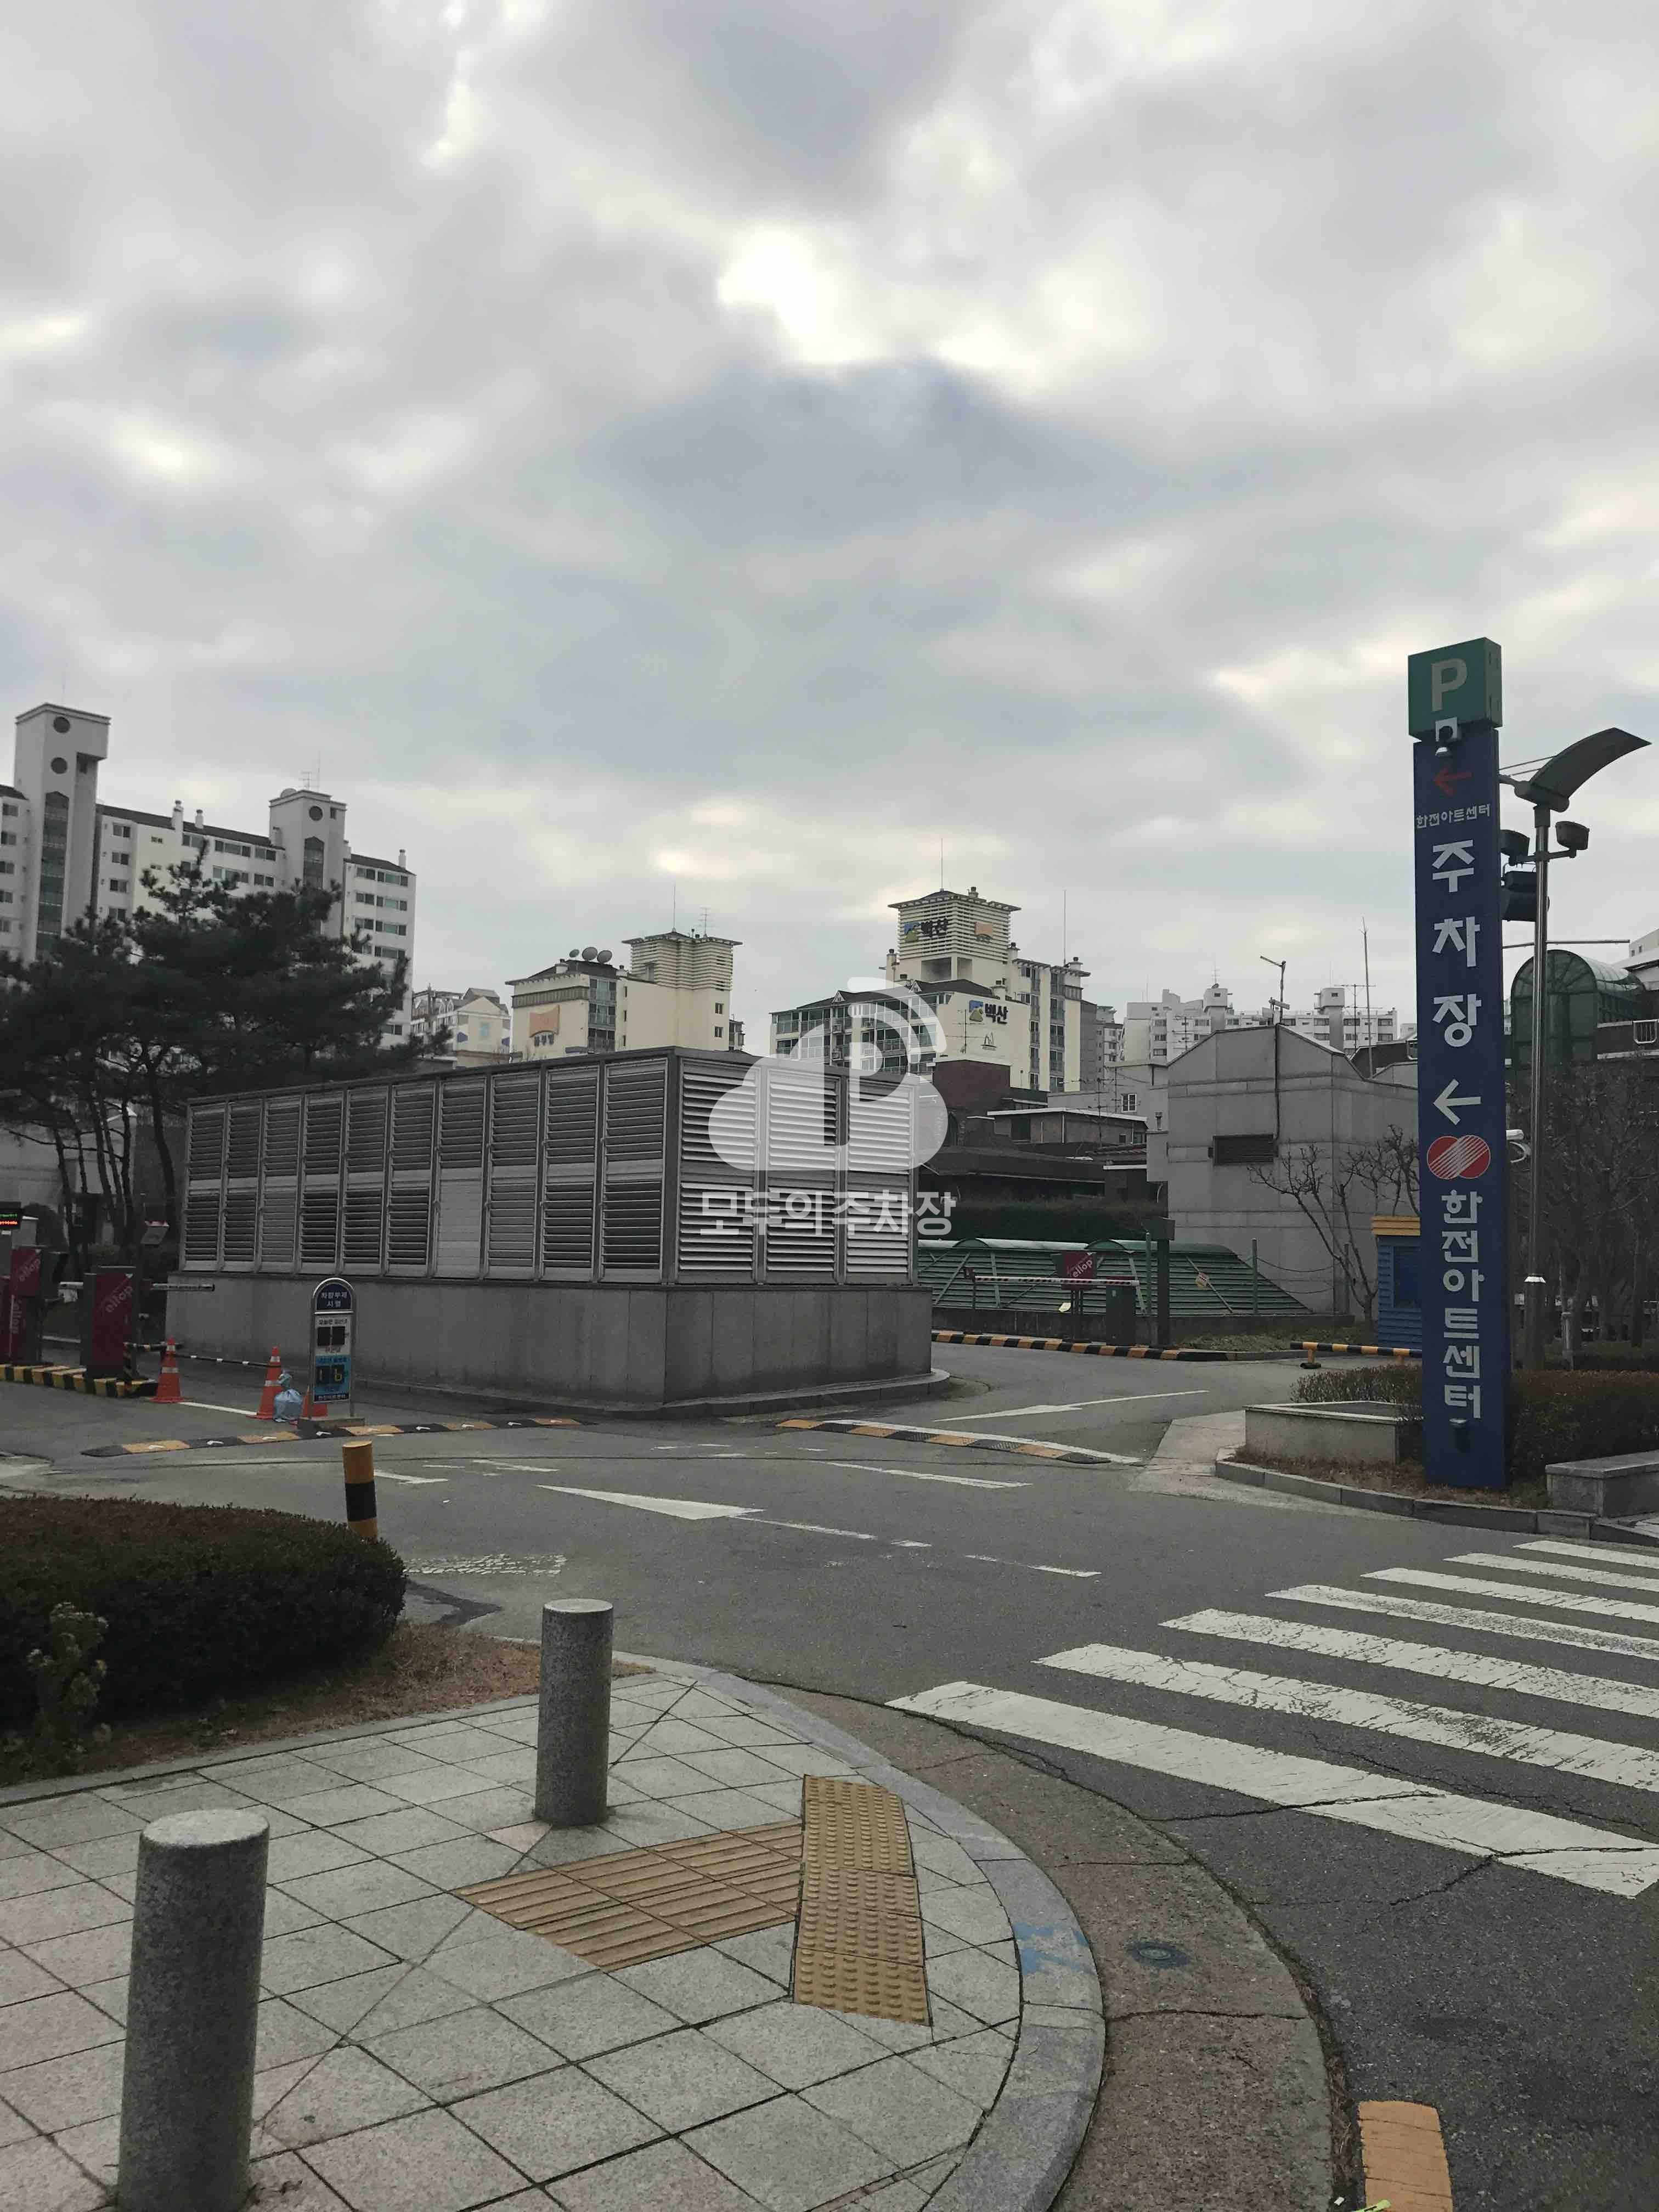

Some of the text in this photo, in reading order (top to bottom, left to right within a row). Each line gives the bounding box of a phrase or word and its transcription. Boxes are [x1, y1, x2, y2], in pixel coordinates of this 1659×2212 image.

[1431, 658, 1467, 712] P
[1417, 803, 1490, 828] 한전아트센터
[1432, 839, 1481, 1047] 주차장
[985, 1003, 1008, 1024] 백산
[1072, 1259, 1093, 1278] ellop
[1441, 1189, 1485, 1418] 한전아트센터
